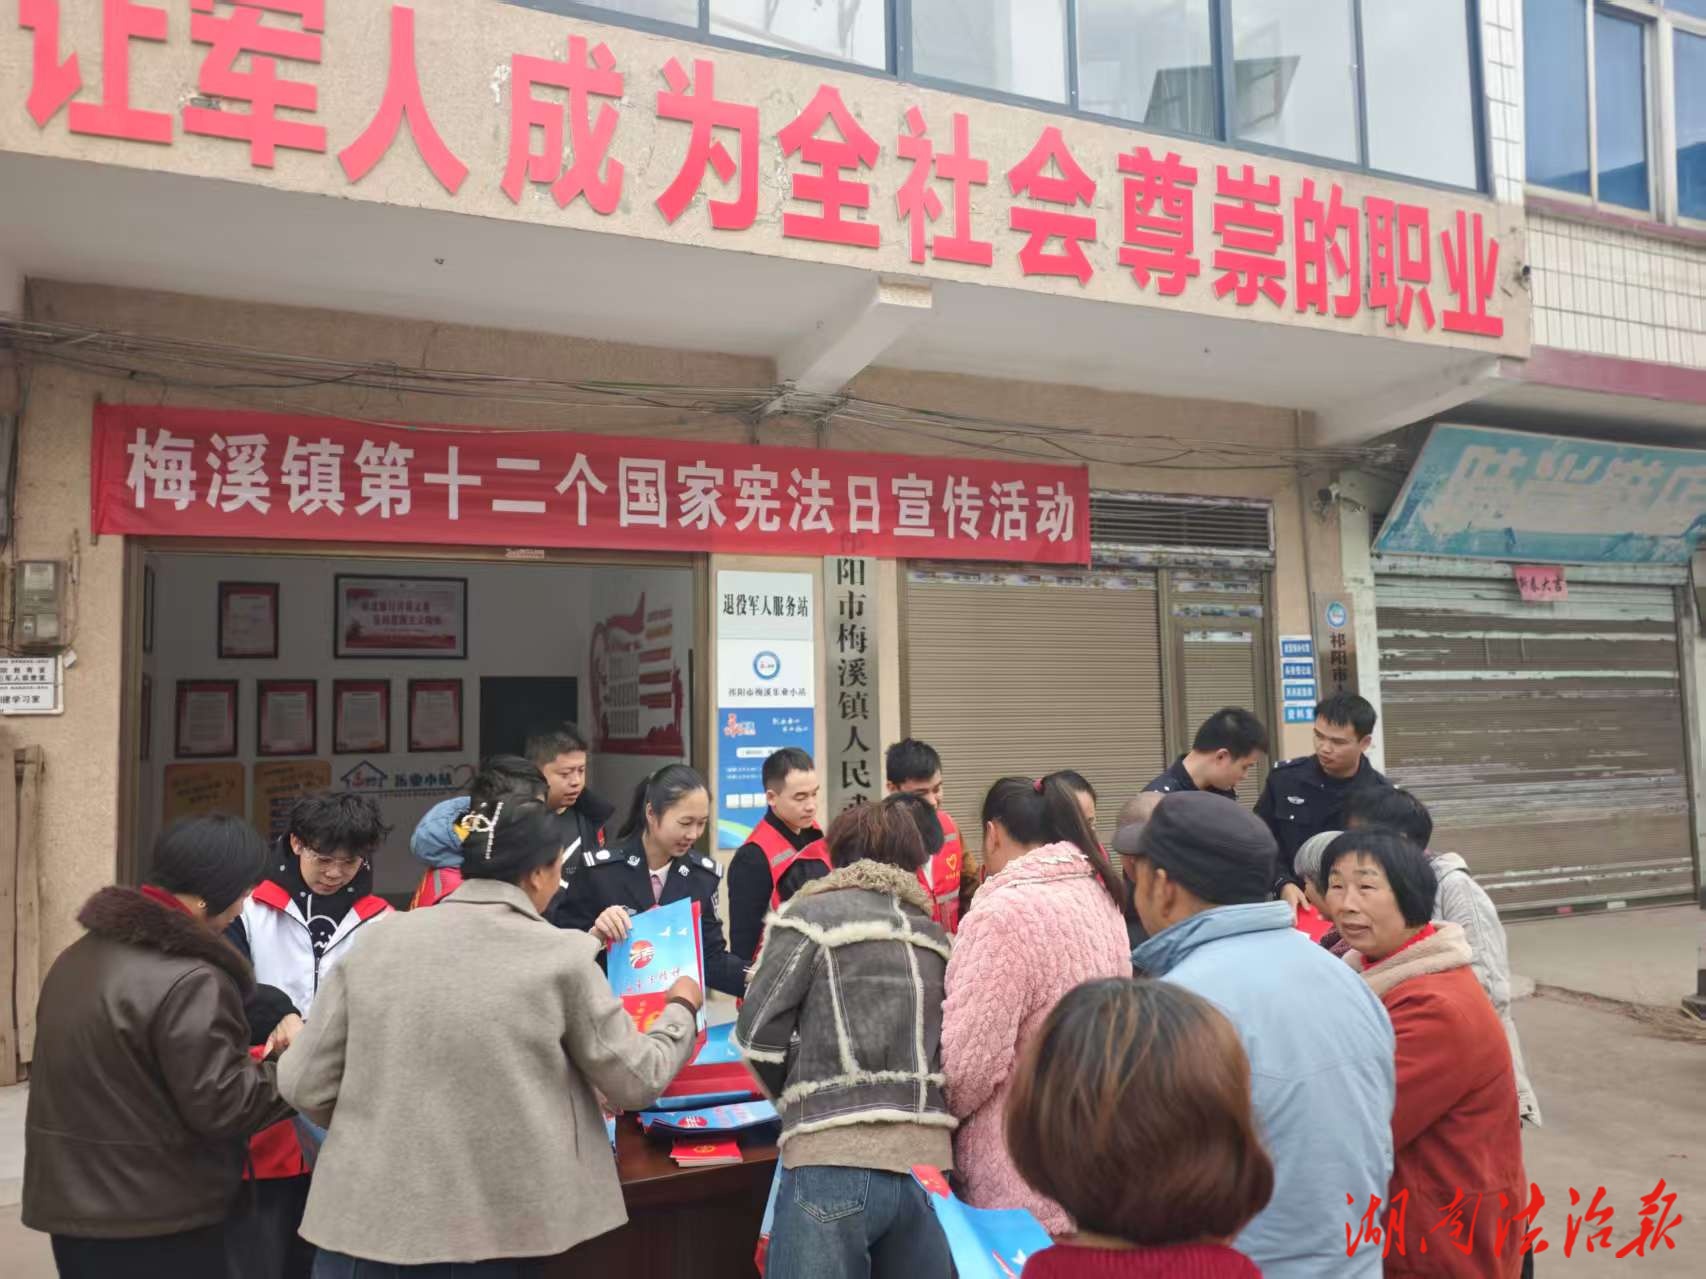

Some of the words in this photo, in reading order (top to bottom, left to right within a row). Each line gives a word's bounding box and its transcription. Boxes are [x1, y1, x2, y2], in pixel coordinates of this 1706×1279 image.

[20, 0, 1503, 337] 让军人成为全社会尊崇的职业
[126, 427, 1077, 545] 梅溪镇第十二个国家宪法日宣传活动
[723, 594, 808, 617] 退役军人服务站
[1328, 632, 1348, 691] 祁阳市
[836, 557, 872, 810] 阳市梅溪镇人民
